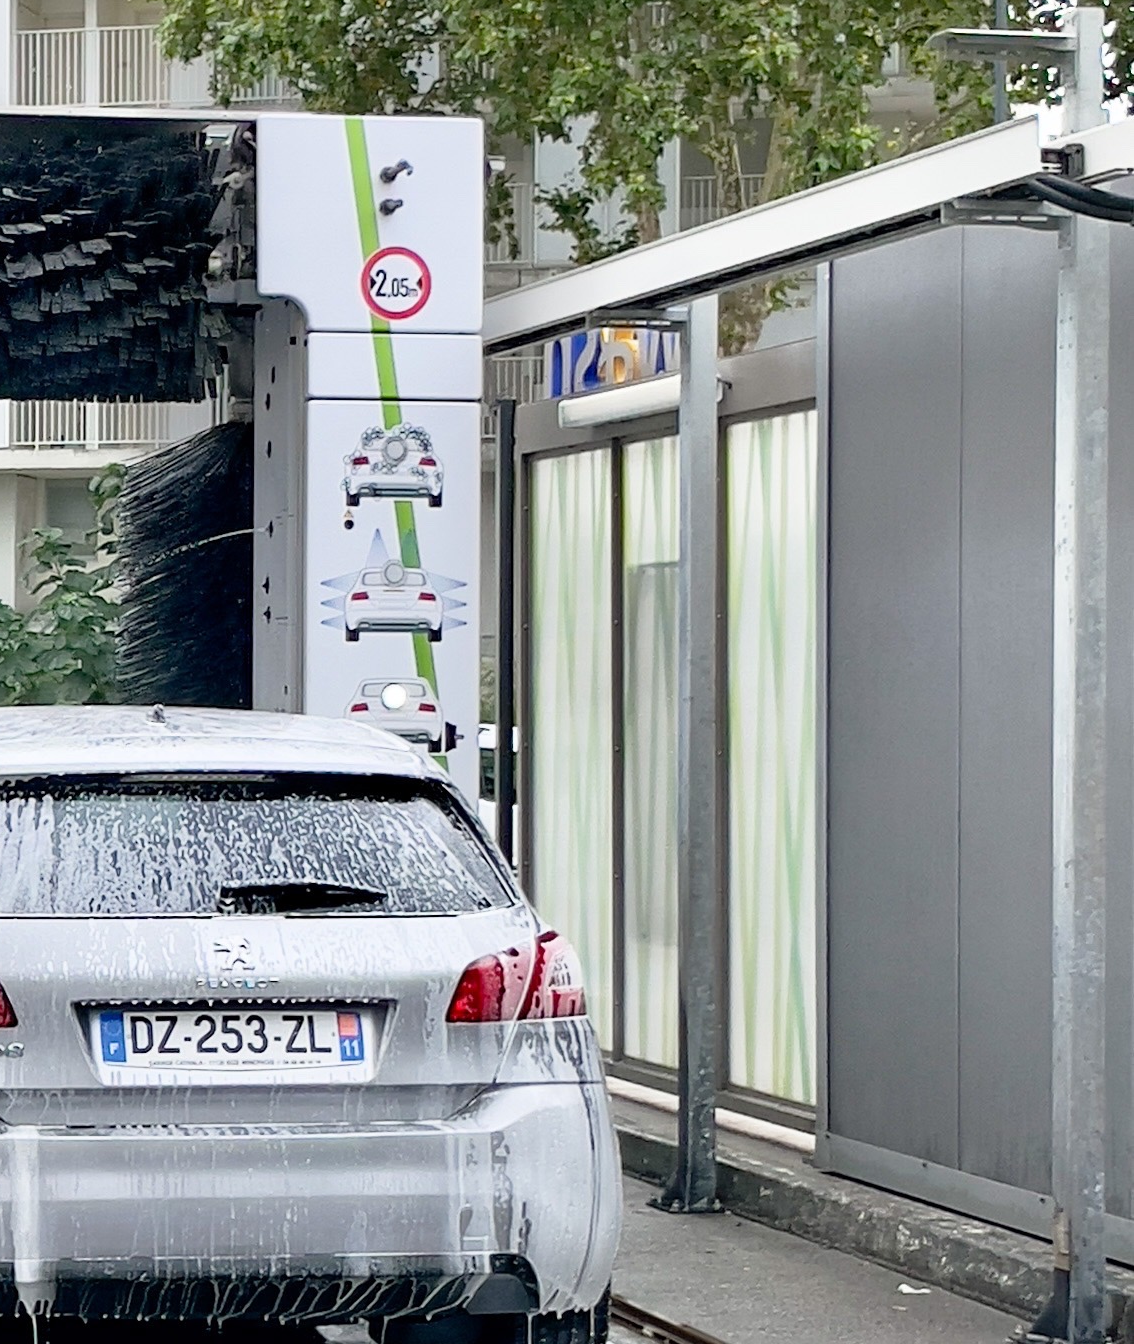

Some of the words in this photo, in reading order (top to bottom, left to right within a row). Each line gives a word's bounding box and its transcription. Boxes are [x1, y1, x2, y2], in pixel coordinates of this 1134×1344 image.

[128, 1013, 333, 1055] DZ-253-ZL
[109, 1042, 119, 1056] F
[342, 1039, 361, 1057] 11
